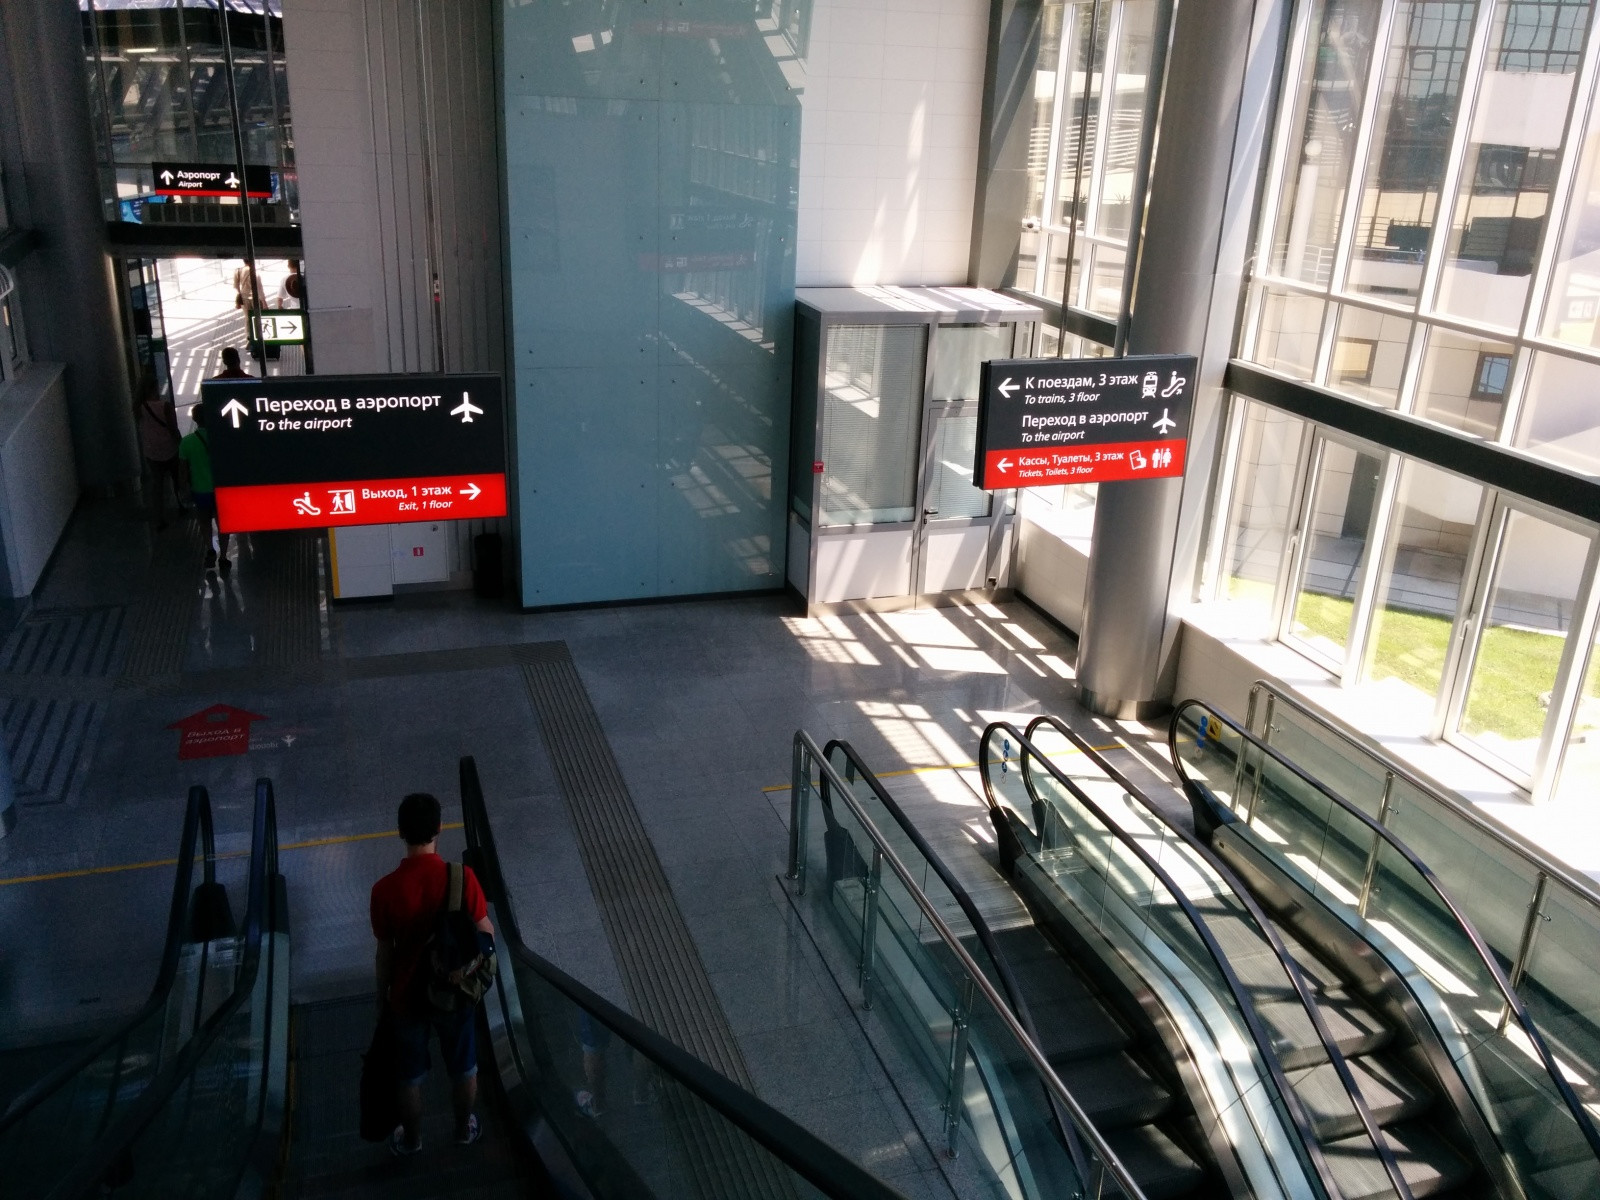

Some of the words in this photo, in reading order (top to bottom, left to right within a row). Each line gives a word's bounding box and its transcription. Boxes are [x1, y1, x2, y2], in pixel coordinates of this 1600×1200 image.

[177, 171, 221, 181] Аэропорт
[1026, 377, 1034, 389] К
[1038, 377, 1095, 389] поездам,
[1099, 374, 1106, 385] 3
[1109, 375, 1138, 385] этаж
[1025, 395, 1036, 404] To
[1038, 394, 1066, 403] trains,
[1069, 393, 1075, 402] 3
[1077, 392, 1100, 401] floor
[256, 397, 337, 415] Переход
[341, 399, 351, 409] в
[356, 395, 442, 412] аэропорт
[258, 420, 275, 430] To
[278, 418, 301, 430] the
[304, 418, 352, 431] airport
[1022, 415, 1077, 429] Переход
[1079, 415, 1086, 424] в
[1089, 411, 1149, 425] аэропорт
[1022, 433, 1032, 442] To
[1035, 432, 1050, 441] the
[1052, 431, 1085, 442] airport
[1018, 456, 1050, 466] Кассы,
[1052, 454, 1093, 466] Туалеты,
[1095, 452, 1100, 461] 3
[1102, 452, 1125, 460] этаж
[1018, 469, 1044, 478] Tickets,
[1046, 468, 1069, 476] Toilets,
[1076, 465, 1094, 474] floor
[362, 488, 408, 499] Выход,
[411, 486, 417, 496] 1
[422, 486, 452, 496] этаж
[399, 502, 419, 511] Exit,
[422, 501, 427, 510] 1
[429, 500, 453, 509] floor
